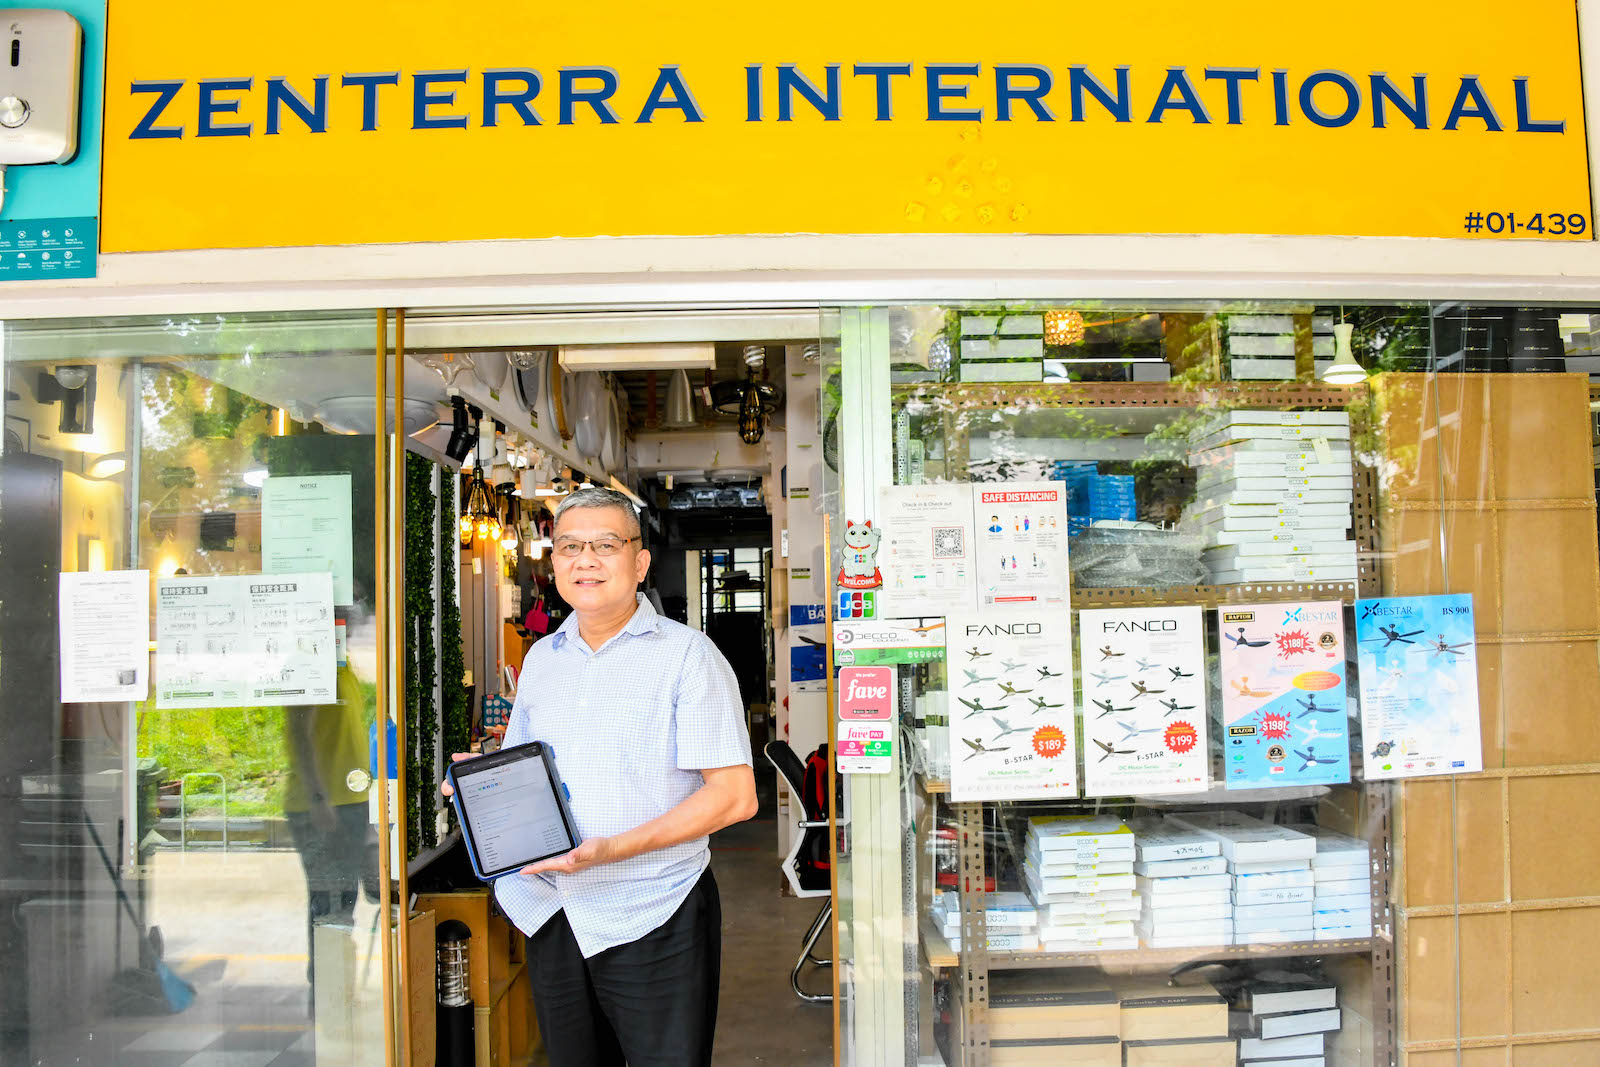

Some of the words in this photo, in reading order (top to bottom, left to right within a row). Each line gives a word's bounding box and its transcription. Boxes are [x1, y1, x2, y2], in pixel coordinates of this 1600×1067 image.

[128, 64, 706, 140] ZENTERRA
[744, 61, 1567, 134] INTERNATIONAL
[1464, 211, 1587, 236] #01-439
[983, 493, 1005, 502] SAFE
[1006, 492, 1056, 502] DISTANCING
[844, 577, 876, 586] WELCOME
[1377, 606, 1413, 616] BESTAR
[1456, 606, 1470, 614] 900
[966, 623, 1042, 636] FANCO
[1103, 620, 1177, 633] FANCO
[1283, 638, 1304, 650] $188!
[845, 679, 887, 702] fave
[1262, 721, 1287, 732] $198!
[847, 728, 869, 739] fave
[1038, 739, 1061, 751] $189
[1170, 735, 1193, 747] $199
[1004, 755, 1033, 765] B-STAR
[1137, 751, 1164, 761] F-STAR
